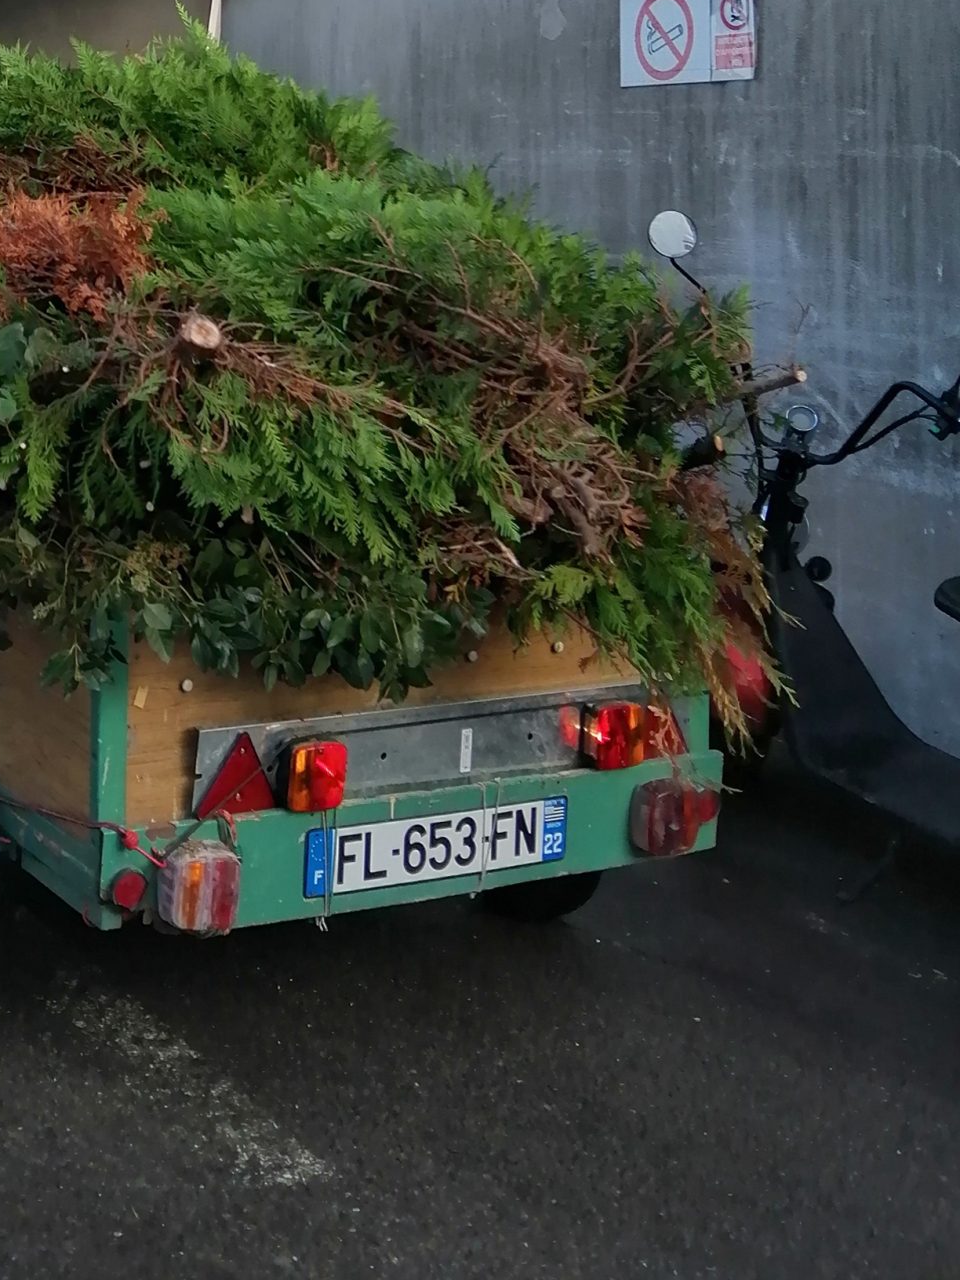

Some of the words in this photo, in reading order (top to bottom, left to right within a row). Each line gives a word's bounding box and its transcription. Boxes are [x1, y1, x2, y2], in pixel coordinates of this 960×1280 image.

[337, 807, 537, 885] FL-653-FN
[544, 832, 563, 854] 22
[314, 871, 324, 885] F
